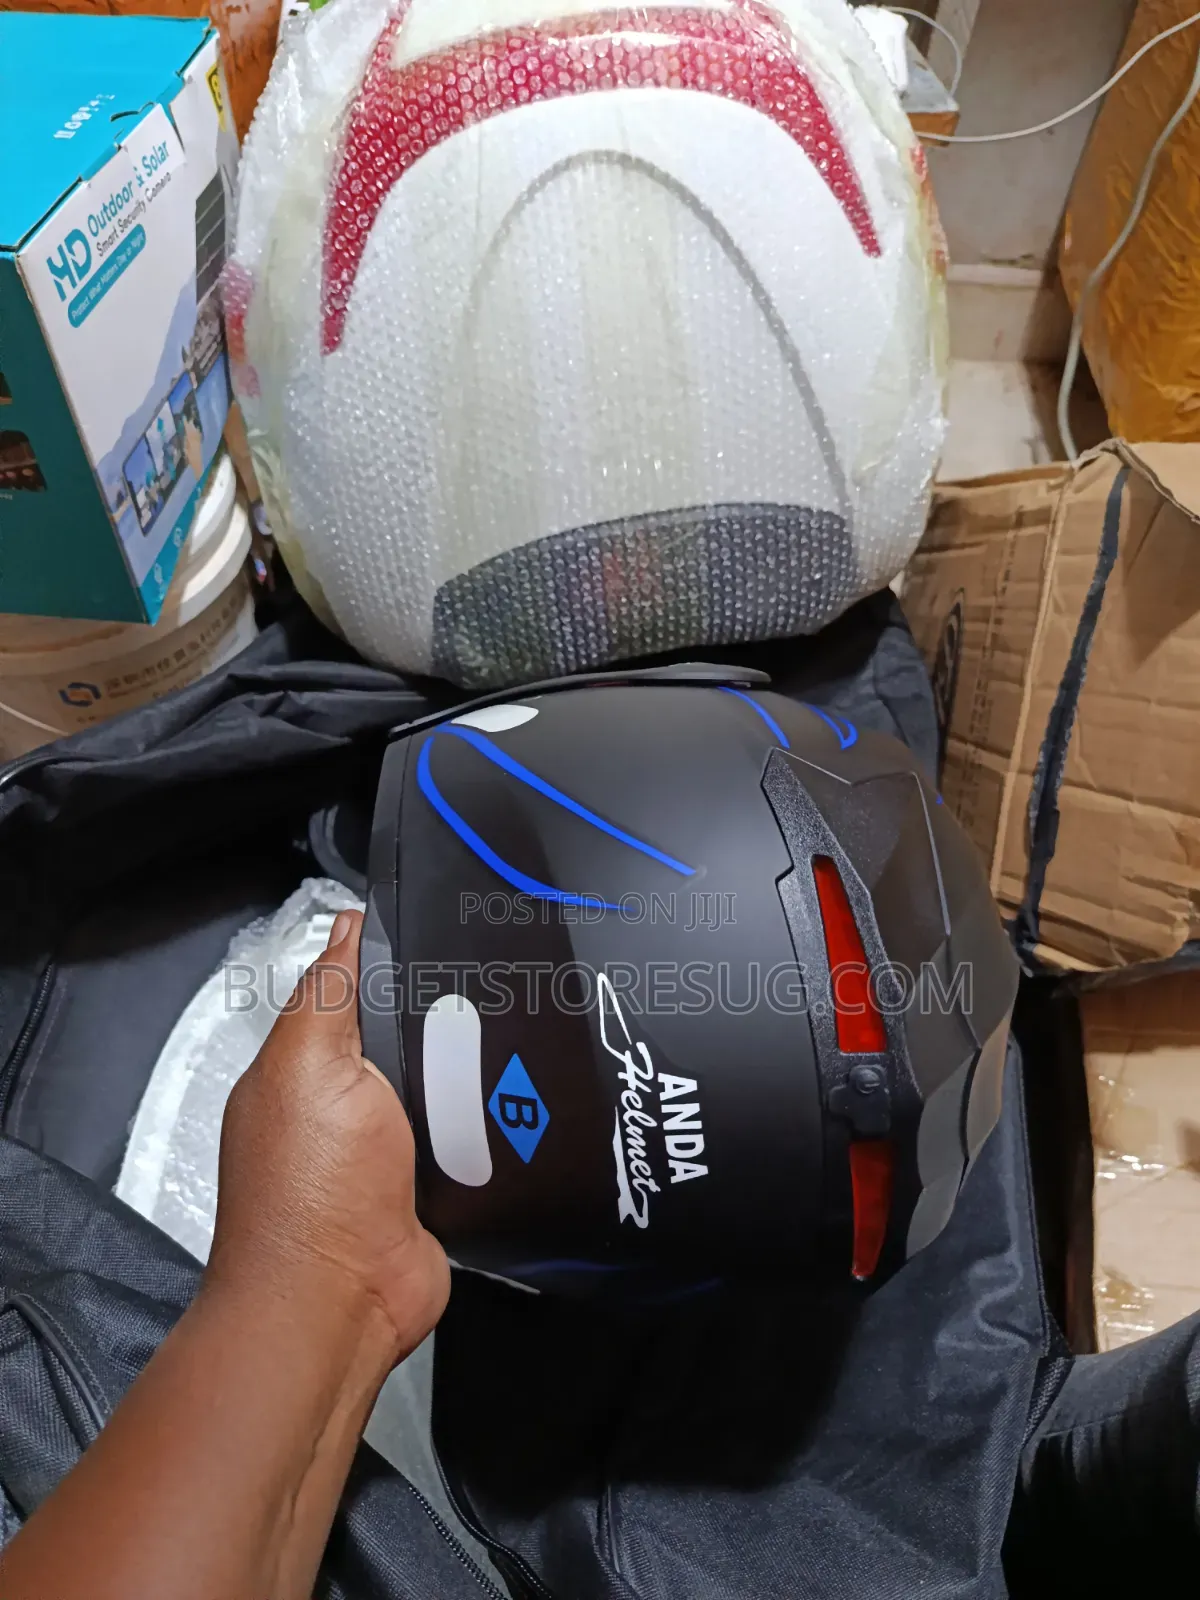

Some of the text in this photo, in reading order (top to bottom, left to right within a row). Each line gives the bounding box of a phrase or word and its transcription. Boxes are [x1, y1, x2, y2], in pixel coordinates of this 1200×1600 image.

[87, 180, 134, 238] Outdoor
[141, 140, 170, 178] Solar
[96, 171, 172, 258] Smart Security Camera
[46, 228, 92, 302] HD
[498, 1092, 539, 1131] B
[657, 1072, 709, 1184] ANDA
